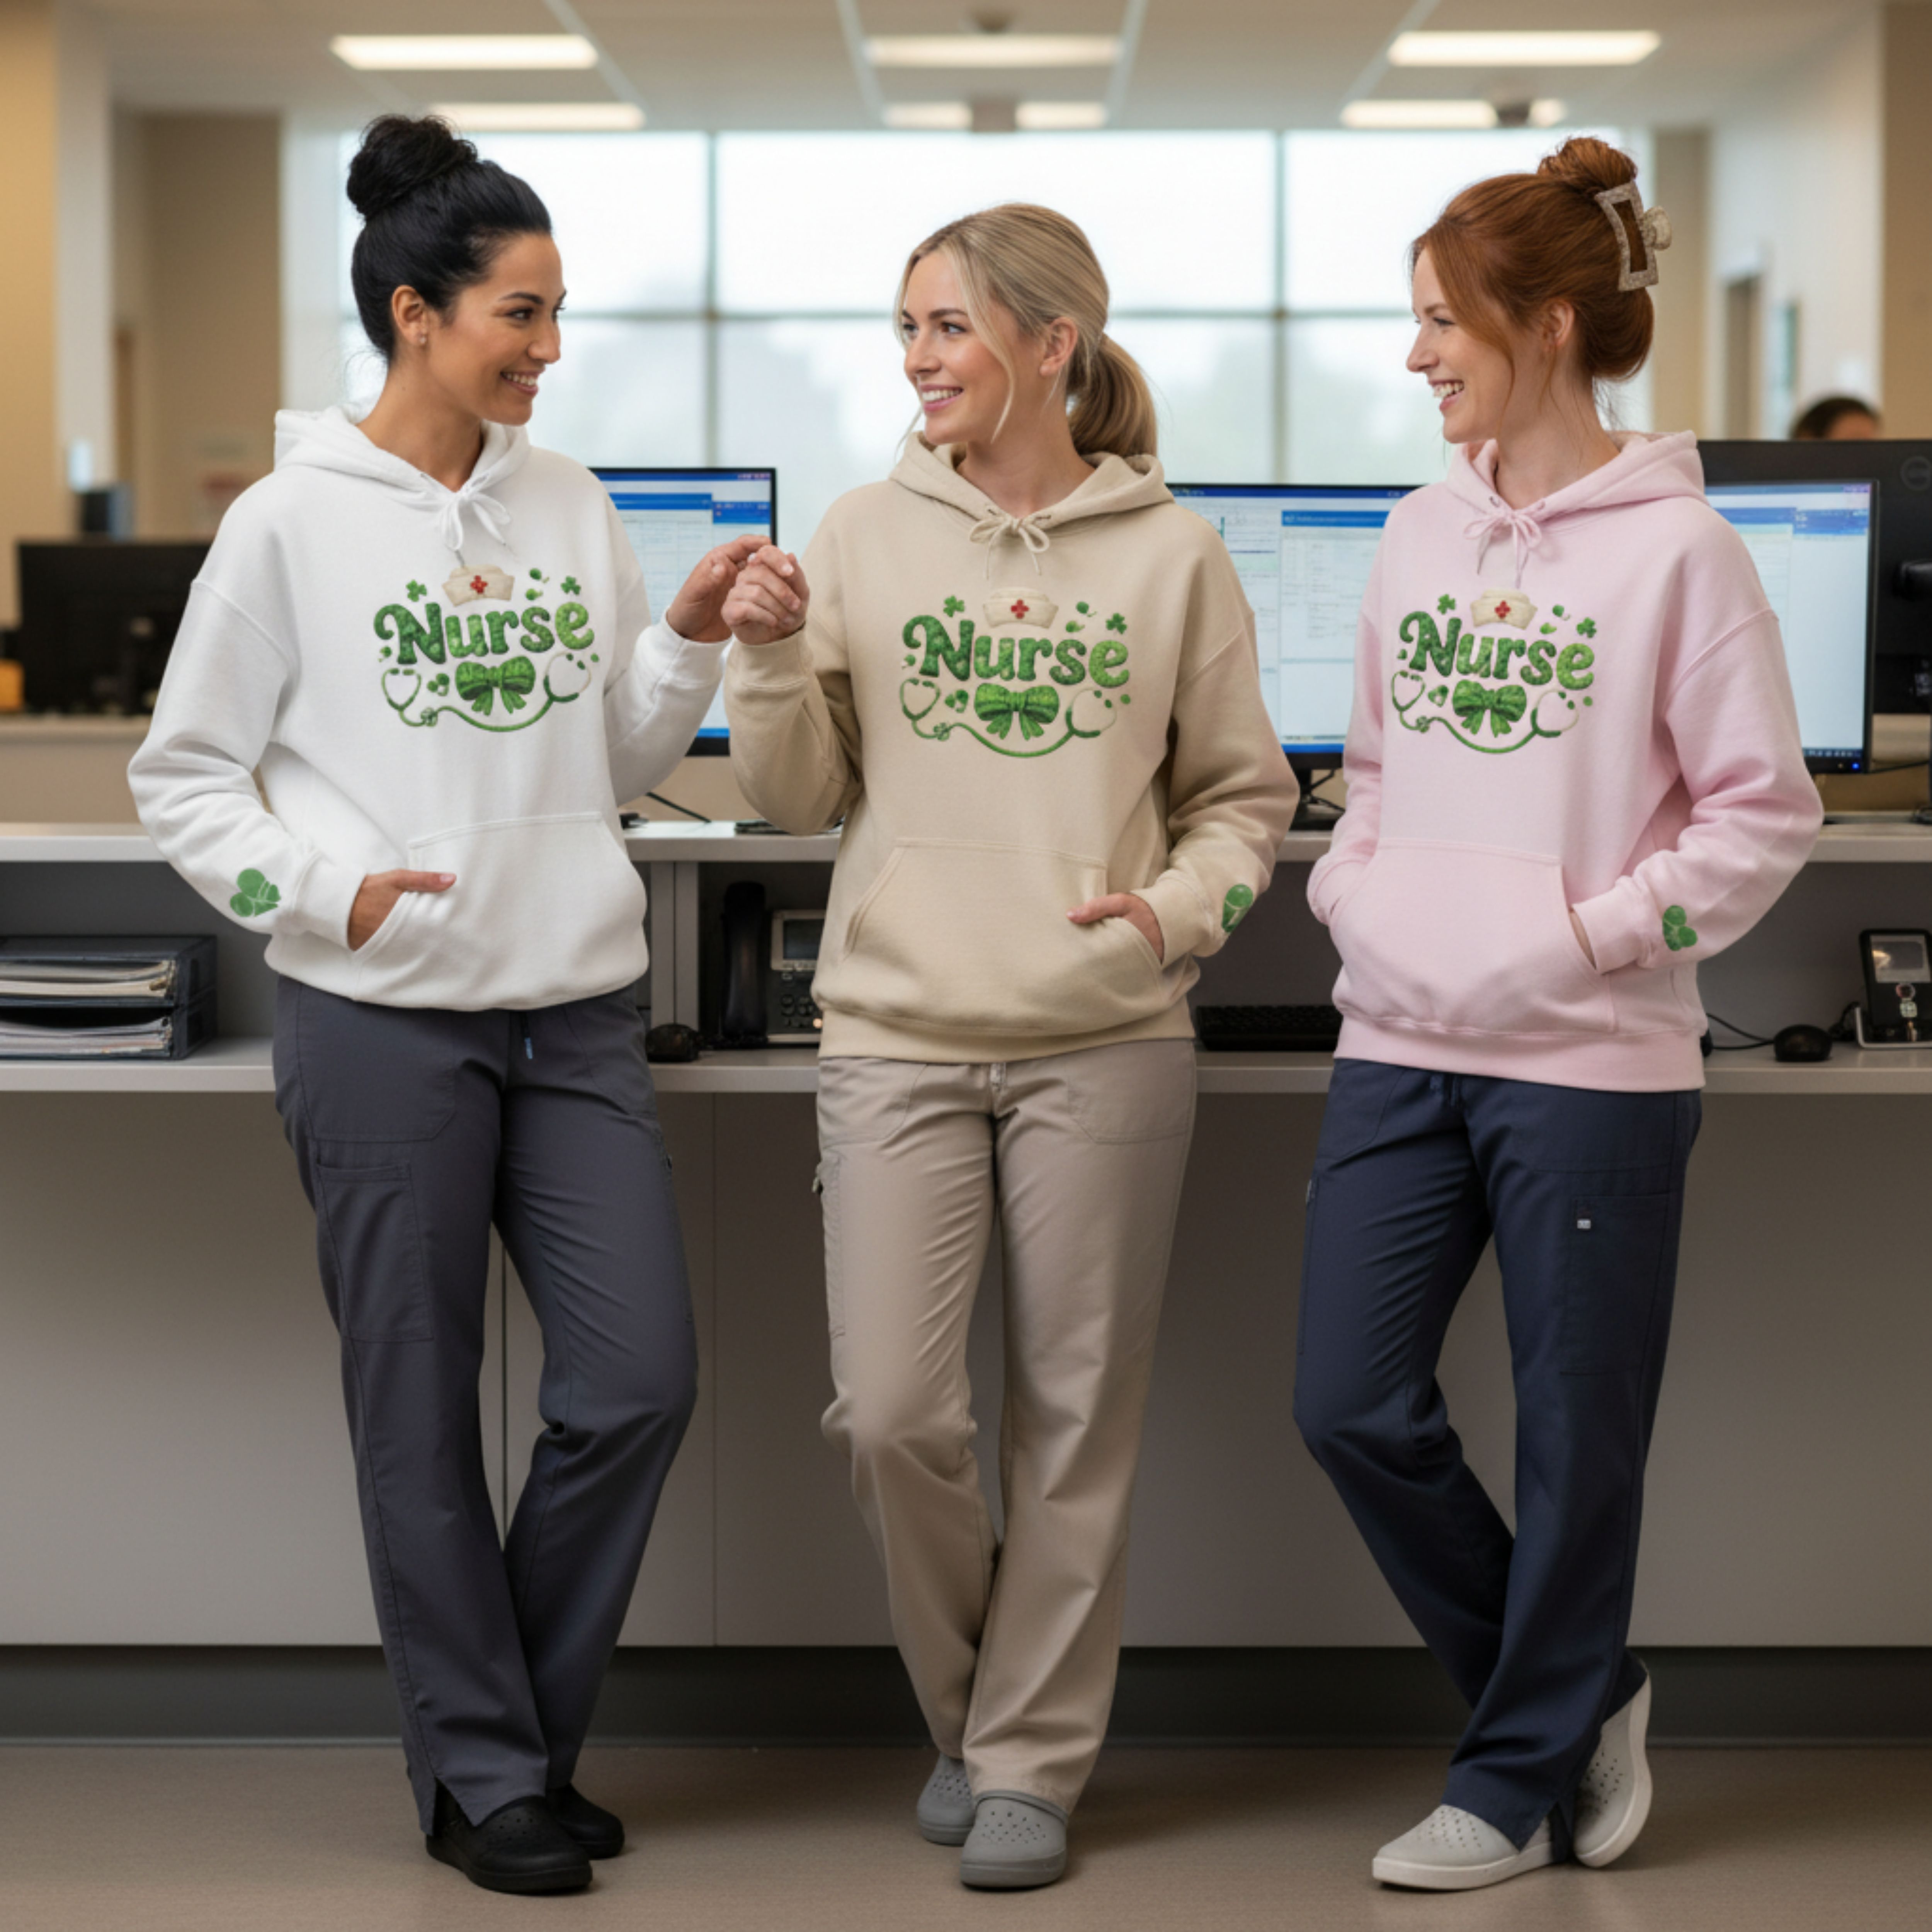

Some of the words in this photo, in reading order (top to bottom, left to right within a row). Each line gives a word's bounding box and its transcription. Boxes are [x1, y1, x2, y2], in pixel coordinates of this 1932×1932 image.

[374, 602, 594, 665] Nurse
[902, 614, 1130, 688] Nurse
[1399, 611, 1595, 690] Nurse
